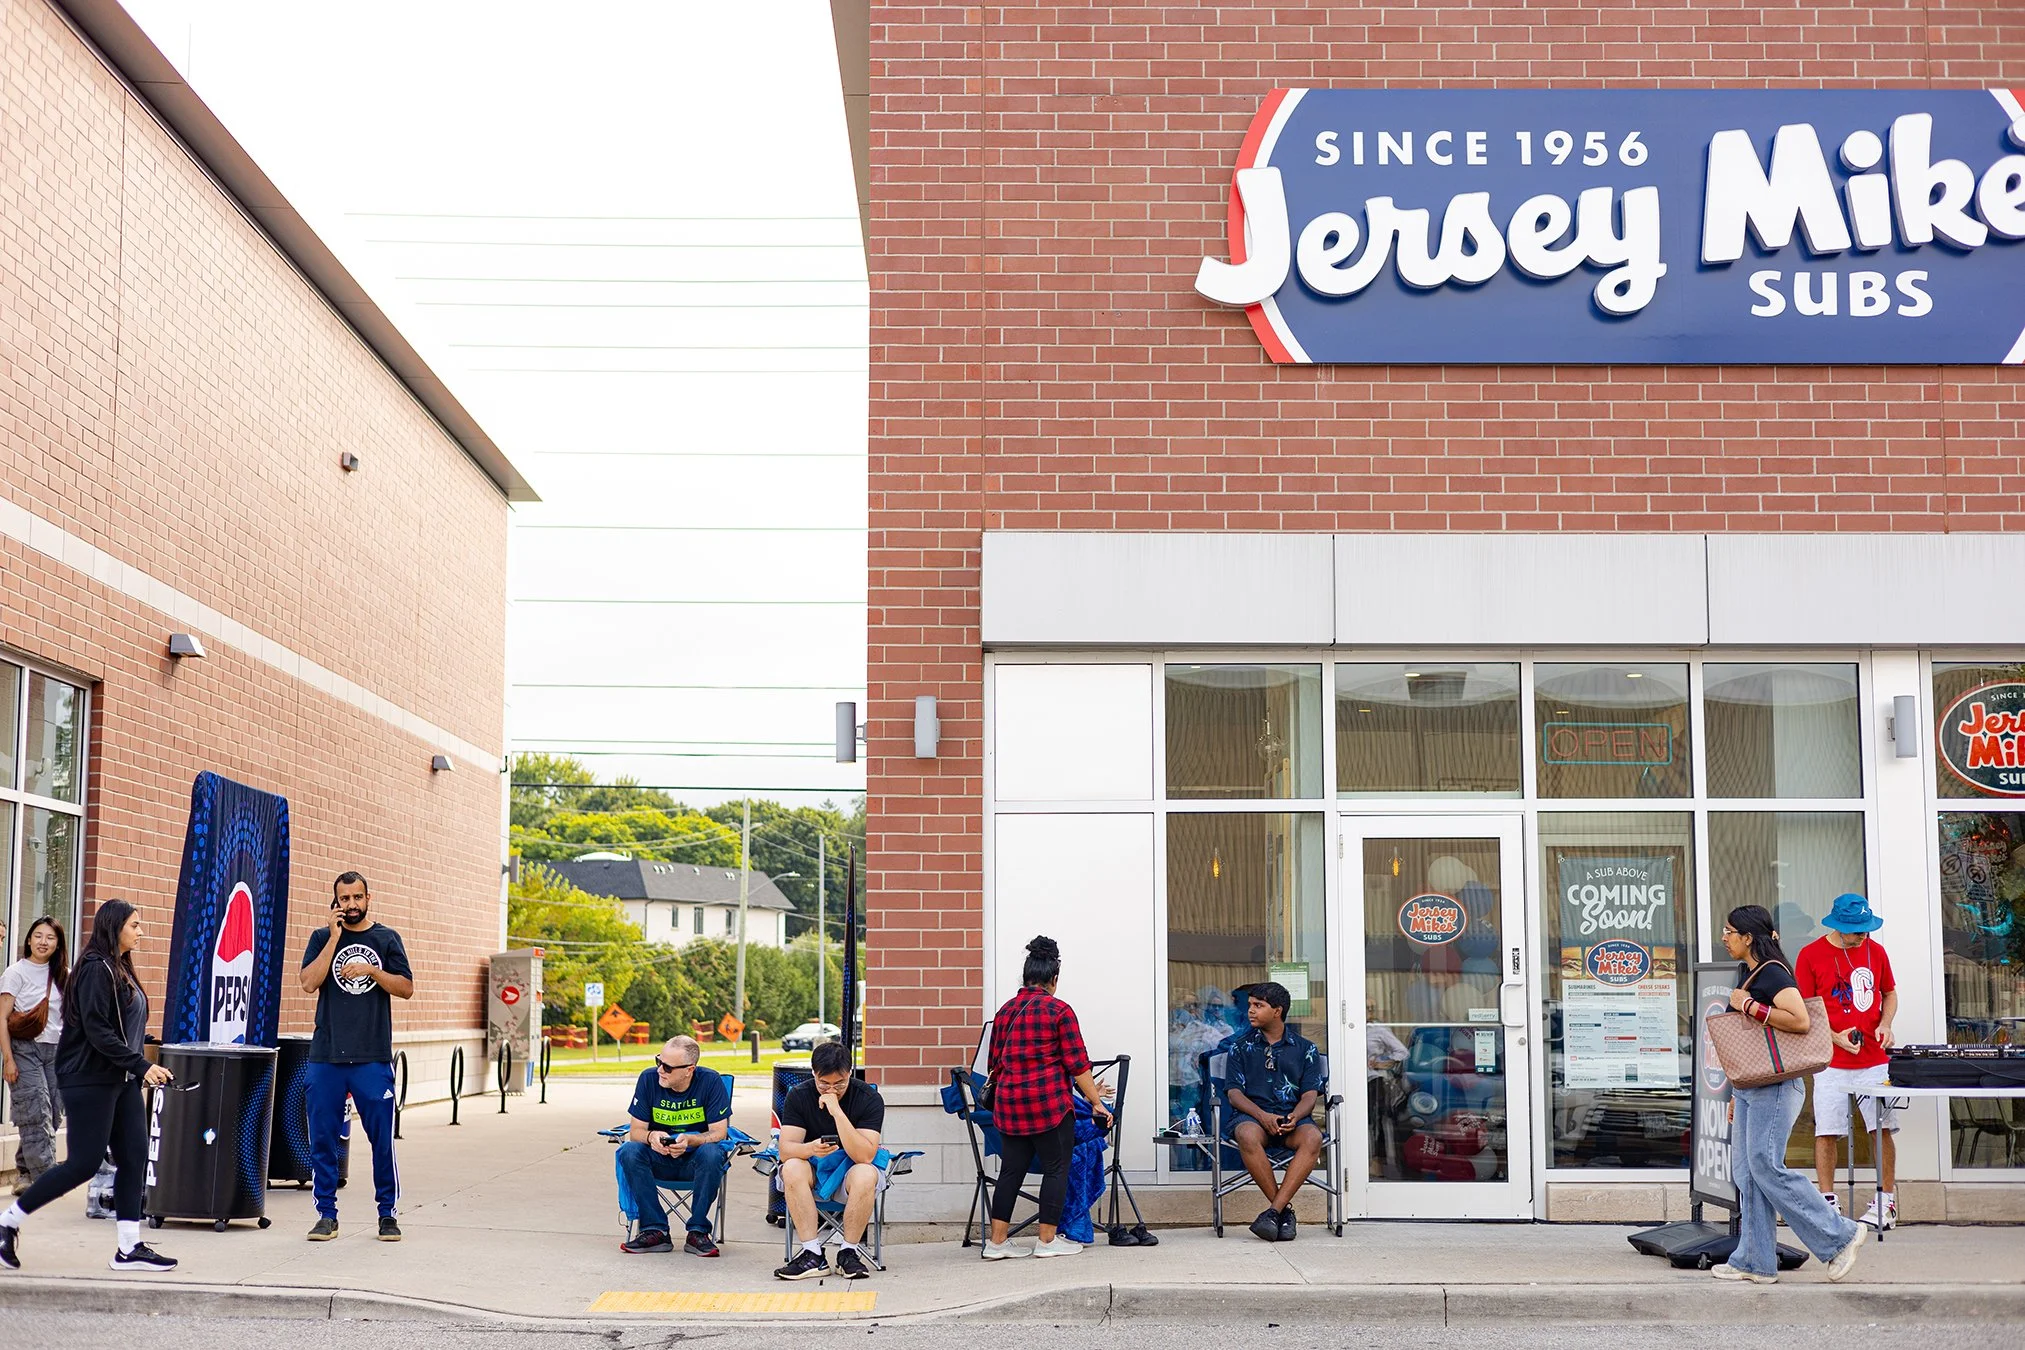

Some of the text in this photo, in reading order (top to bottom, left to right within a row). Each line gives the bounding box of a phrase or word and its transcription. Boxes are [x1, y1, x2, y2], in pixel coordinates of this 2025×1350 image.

[1314, 130, 1649, 167] SINCE 1956
[1194, 166, 1667, 316] Jersey
[1749, 269, 1933, 318] SUBS
[1990, 692, 2018, 702] SINCE
[1551, 729, 1664, 758] OPEN
[1586, 867, 1648, 881] A SUB ABOVE
[1567, 884, 1666, 905] COMING
[1407, 902, 1458, 923] Jersey
[1580, 901, 1657, 935] Soon!
[1410, 916, 1458, 933] Mike's
[1594, 947, 1642, 965] Jersey
[1596, 960, 1642, 975] Mike's
[660, 1098, 697, 1109] SEATTLE
[655, 1111, 701, 1122] SEAHAWKS
[1700, 1098, 1730, 1139] NOW
[1697, 1138, 1731, 1182] OPEN
